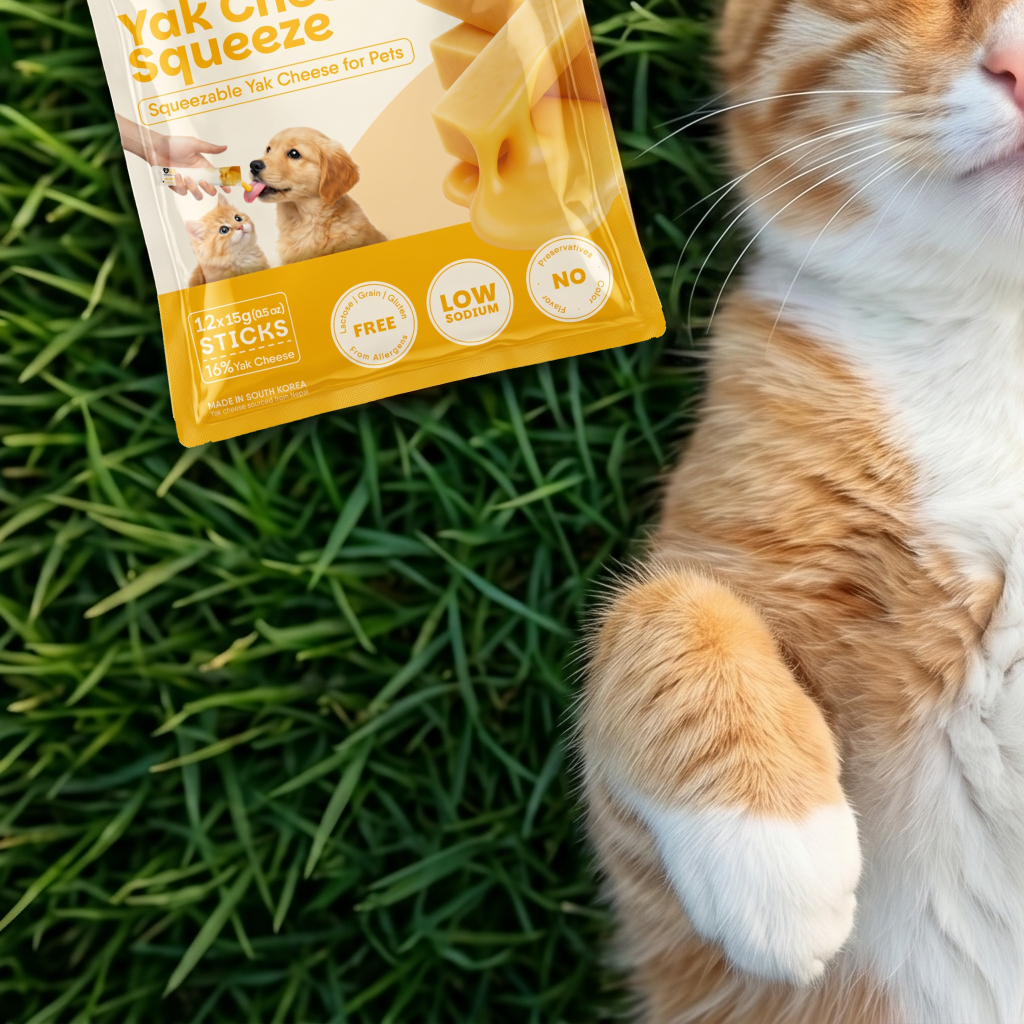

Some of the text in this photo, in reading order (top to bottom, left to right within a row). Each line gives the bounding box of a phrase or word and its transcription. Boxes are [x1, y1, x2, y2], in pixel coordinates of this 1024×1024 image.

[129, 13, 333, 86] Squeeze
[148, 48, 404, 117] Squeezable Yak Cheese for Pets
[535, 239, 593, 268] Preservatives
[552, 268, 586, 290] NO
[589, 280, 609, 304] Color
[333, 289, 407, 334] Lactose Grain Gluten
[439, 282, 496, 313] LOW
[541, 295, 566, 318] Flavor
[353, 316, 396, 338] FREE
[445, 303, 500, 323] SODIUM
[200, 319, 289, 354] STICKS
[350, 335, 412, 364] From Allergens
[254, 351, 295, 367] Cheese
[208, 380, 307, 409] MADE IN SOUTH KOREA
